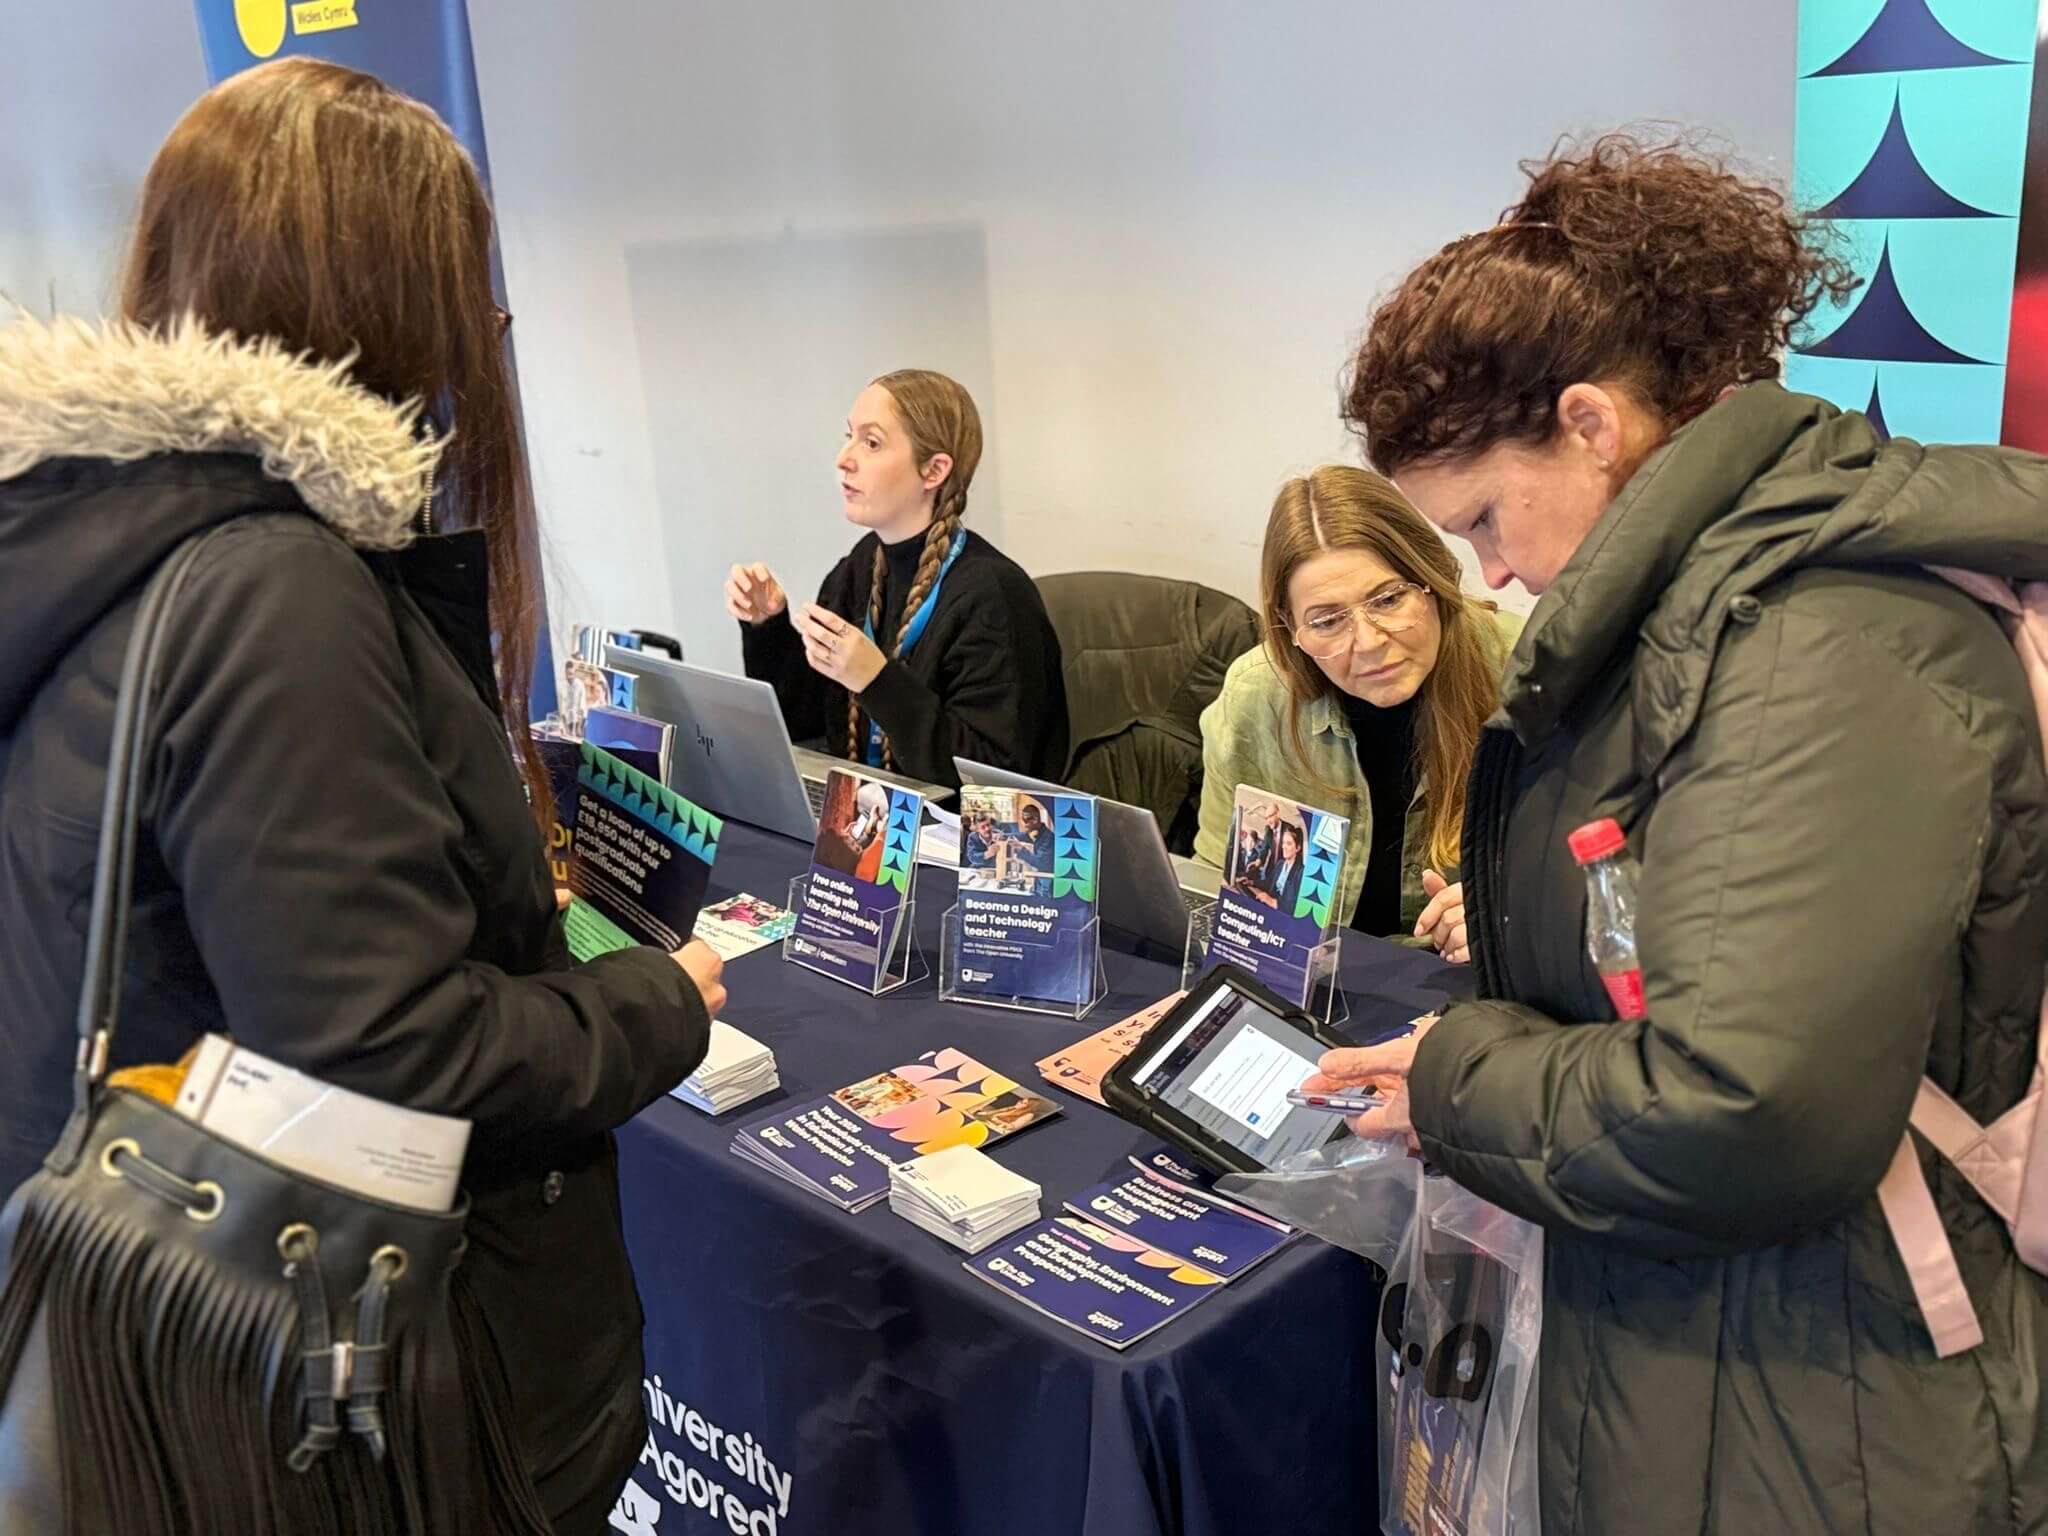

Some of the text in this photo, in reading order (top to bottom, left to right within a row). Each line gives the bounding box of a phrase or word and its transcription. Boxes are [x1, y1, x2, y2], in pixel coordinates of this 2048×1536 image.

[579, 794, 672, 859] Get a loan of up to
[574, 843, 643, 895] qualifications
[575, 827, 646, 878] postgraduate
[618, 836, 641, 857] with
[641, 852, 660, 869] our
[810, 885, 859, 911] learning with
[813, 873, 854, 895] Free online
[807, 898, 821, 911] The
[821, 903, 841, 918] Open
[841, 911, 880, 935] University
[964, 914, 1052, 933] and Technology
[965, 898, 1058, 919] Become a Design
[1223, 898, 1265, 925] Become a
[965, 926, 1008, 939] teacher
[1217, 925, 1251, 948] teacher
[1220, 912, 1286, 948] Computing/ICT
[807, 1110, 863, 1147] Postgraduate
[821, 1105, 842, 1121] Your
[784, 1119, 812, 1139] Wales
[807, 1136, 855, 1167] Prospectus
[804, 1121, 846, 1149] Education
[1112, 1187, 1176, 1221] Prospectus
[1122, 1182, 1201, 1221] Management
[1132, 1176, 1183, 1203] Business
[1182, 1200, 1210, 1214] and
[1013, 1245, 1077, 1282] Prospectus
[1025, 1240, 1126, 1294] and Development
[1037, 1233, 1175, 1306] Geography, Environment
[643, 1374, 792, 1518] niversity
[639, 1425, 777, 1536] Agored
